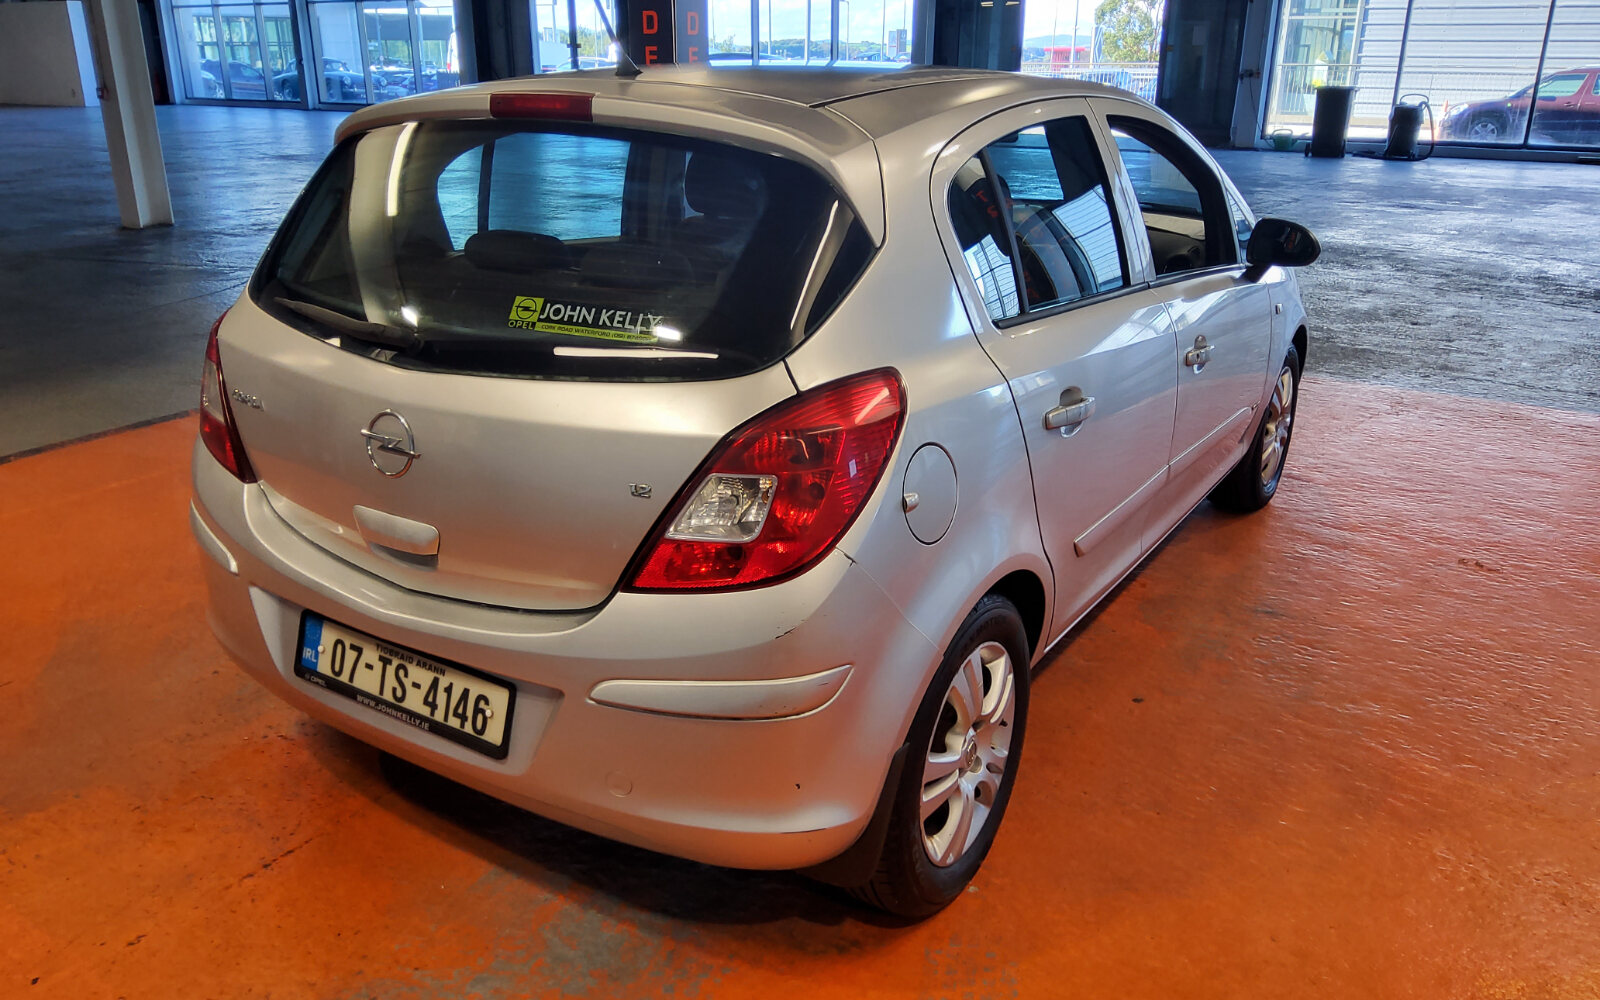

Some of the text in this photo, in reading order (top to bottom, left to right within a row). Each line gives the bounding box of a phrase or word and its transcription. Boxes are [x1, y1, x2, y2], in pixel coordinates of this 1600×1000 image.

[508, 320, 536, 330] OPEL
[539, 303, 662, 331] JOHN KELLY
[574, 328, 611, 338] WATERFORD
[303, 647, 317, 662] IRL
[330, 638, 490, 736] 07-TS-4146
[357, 694, 430, 731] WWW.JOHNKELLY.IE
